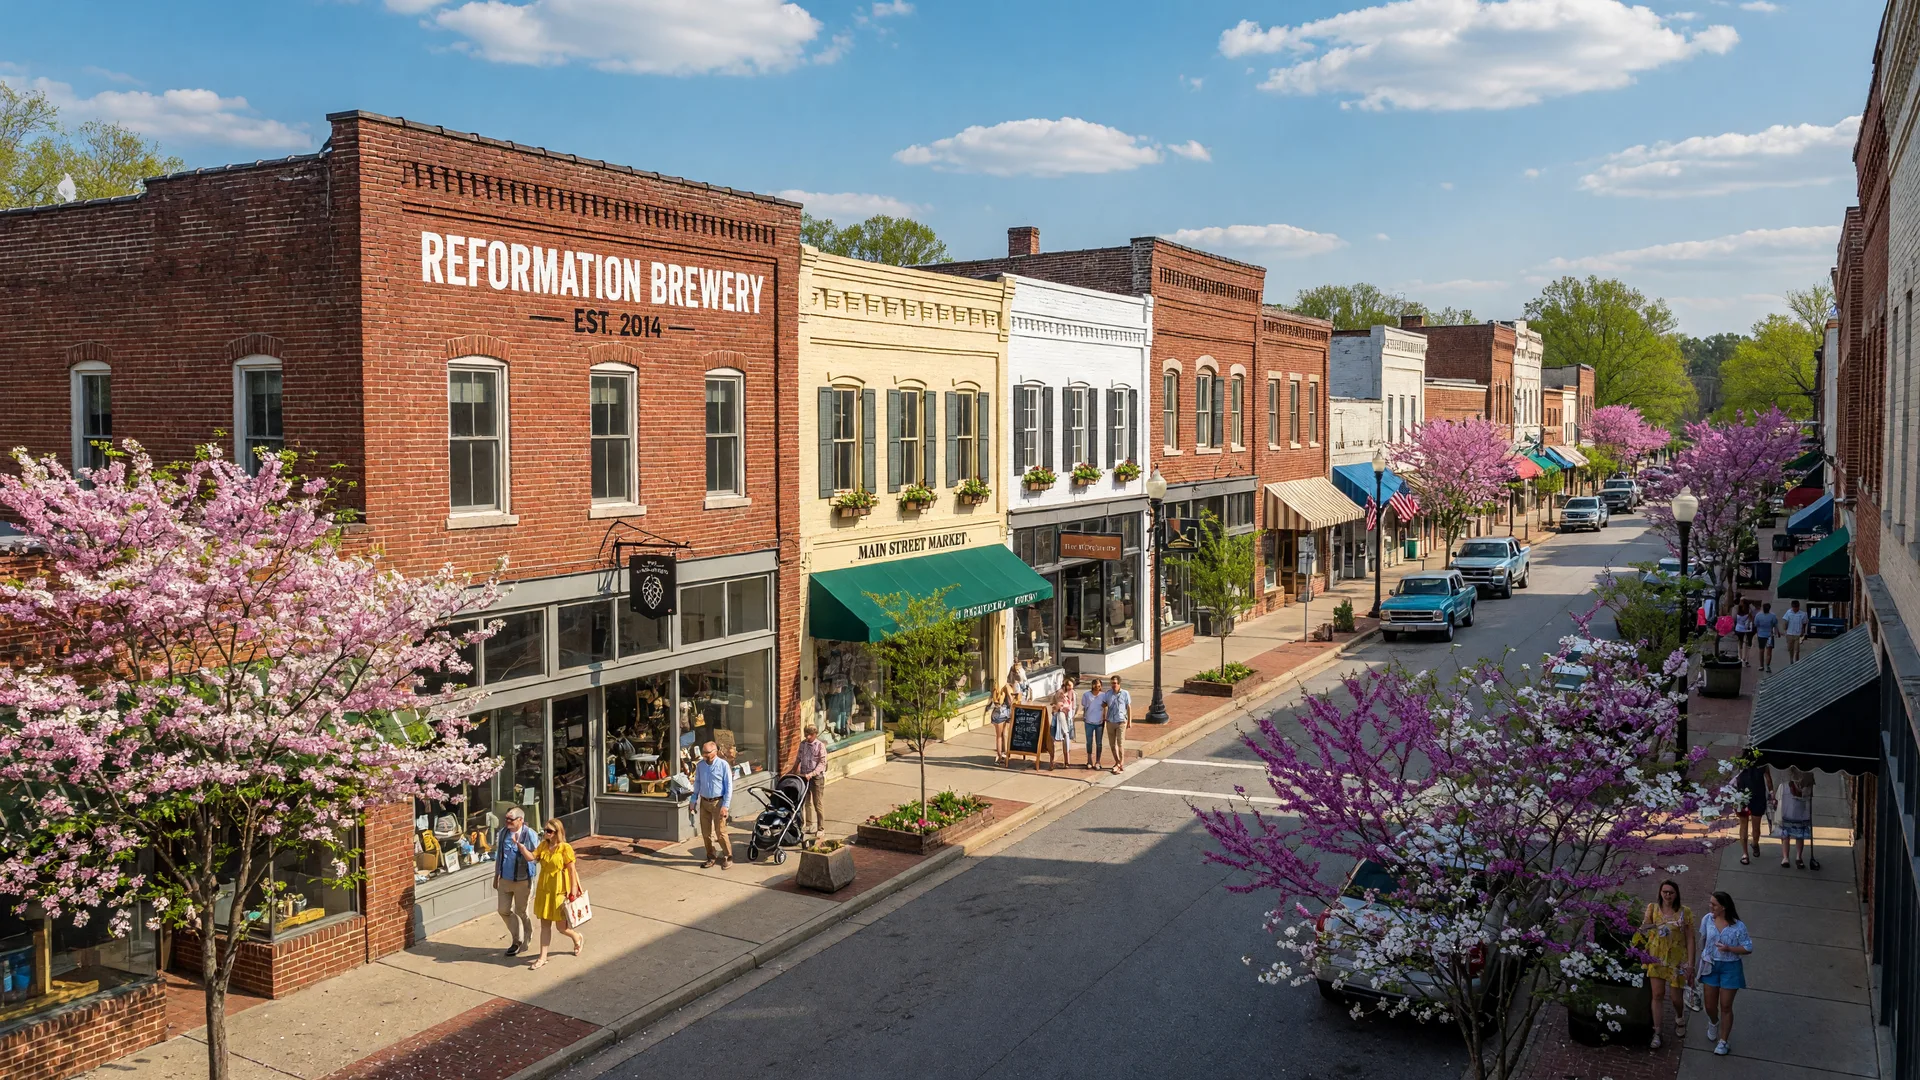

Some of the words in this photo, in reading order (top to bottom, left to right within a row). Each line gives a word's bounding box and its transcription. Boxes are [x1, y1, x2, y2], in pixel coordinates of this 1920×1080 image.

[421, 231, 641, 303] REFORMATION
[650, 261, 764, 314] BREWERY
[574, 308, 612, 336] EST.
[619, 312, 662, 338] 2014
[858, 543, 887, 560] MAIN
[888, 537, 926, 556] STREET
[928, 532, 967, 550] MARKET
